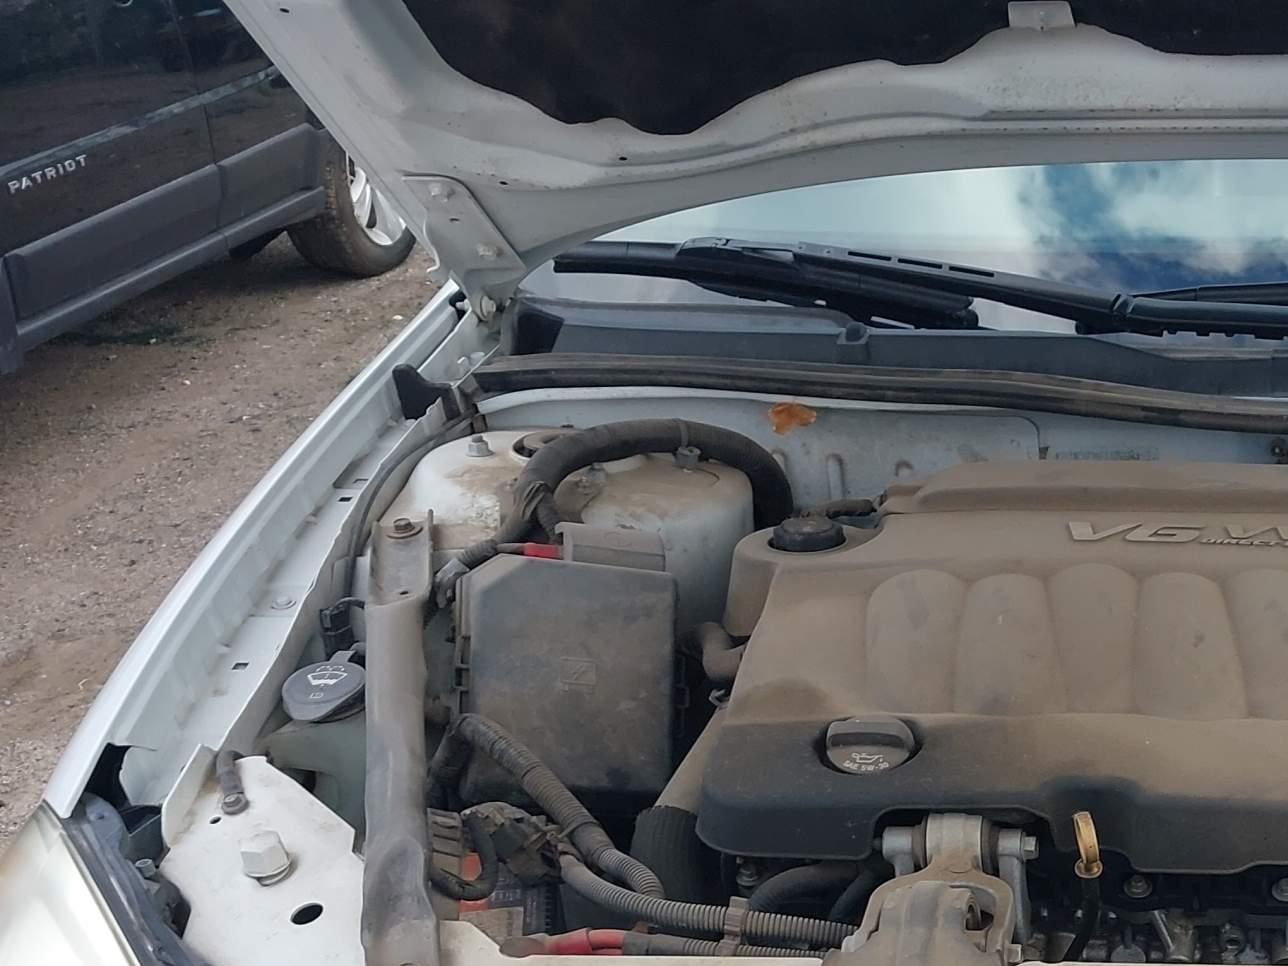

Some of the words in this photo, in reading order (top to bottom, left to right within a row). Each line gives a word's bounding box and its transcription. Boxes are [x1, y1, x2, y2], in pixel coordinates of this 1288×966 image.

[7, 154, 87, 195] PATRIOT
[1068, 521, 1205, 543] V6
[1202, 537, 1283, 546] DIRECT
